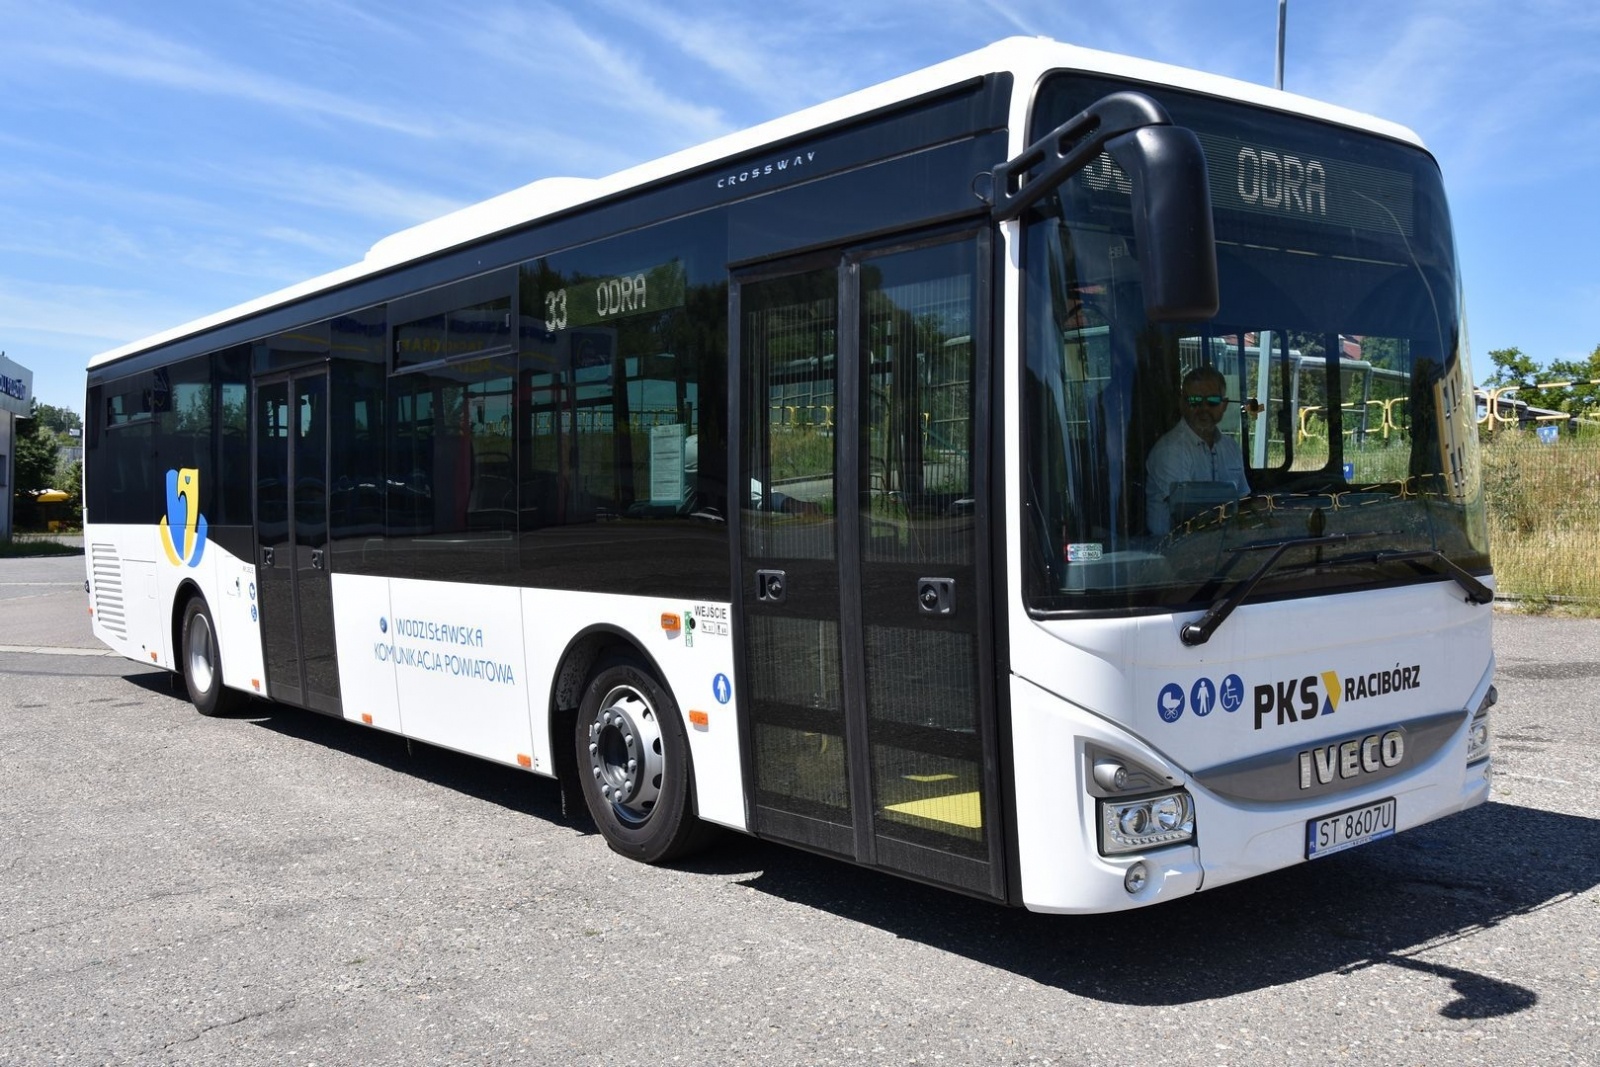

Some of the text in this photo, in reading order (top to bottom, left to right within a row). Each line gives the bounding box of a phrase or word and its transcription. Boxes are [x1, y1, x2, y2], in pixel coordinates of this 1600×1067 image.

[717, 151, 815, 188] CROSSWAY
[1237, 147, 1326, 215] ODRA
[545, 273, 647, 332] 33 ODRA
[395, 618, 483, 647] WODZISŁAWSKA
[694, 604, 727, 619] WEJŚCIE
[374, 643, 515, 685] KOMUNIKACJA POWIATOWA
[1254, 662, 1420, 730] PKS RACIBÓRZ
[1299, 730, 1404, 790] IVECO
[1320, 803, 1391, 847] ST 8607U
